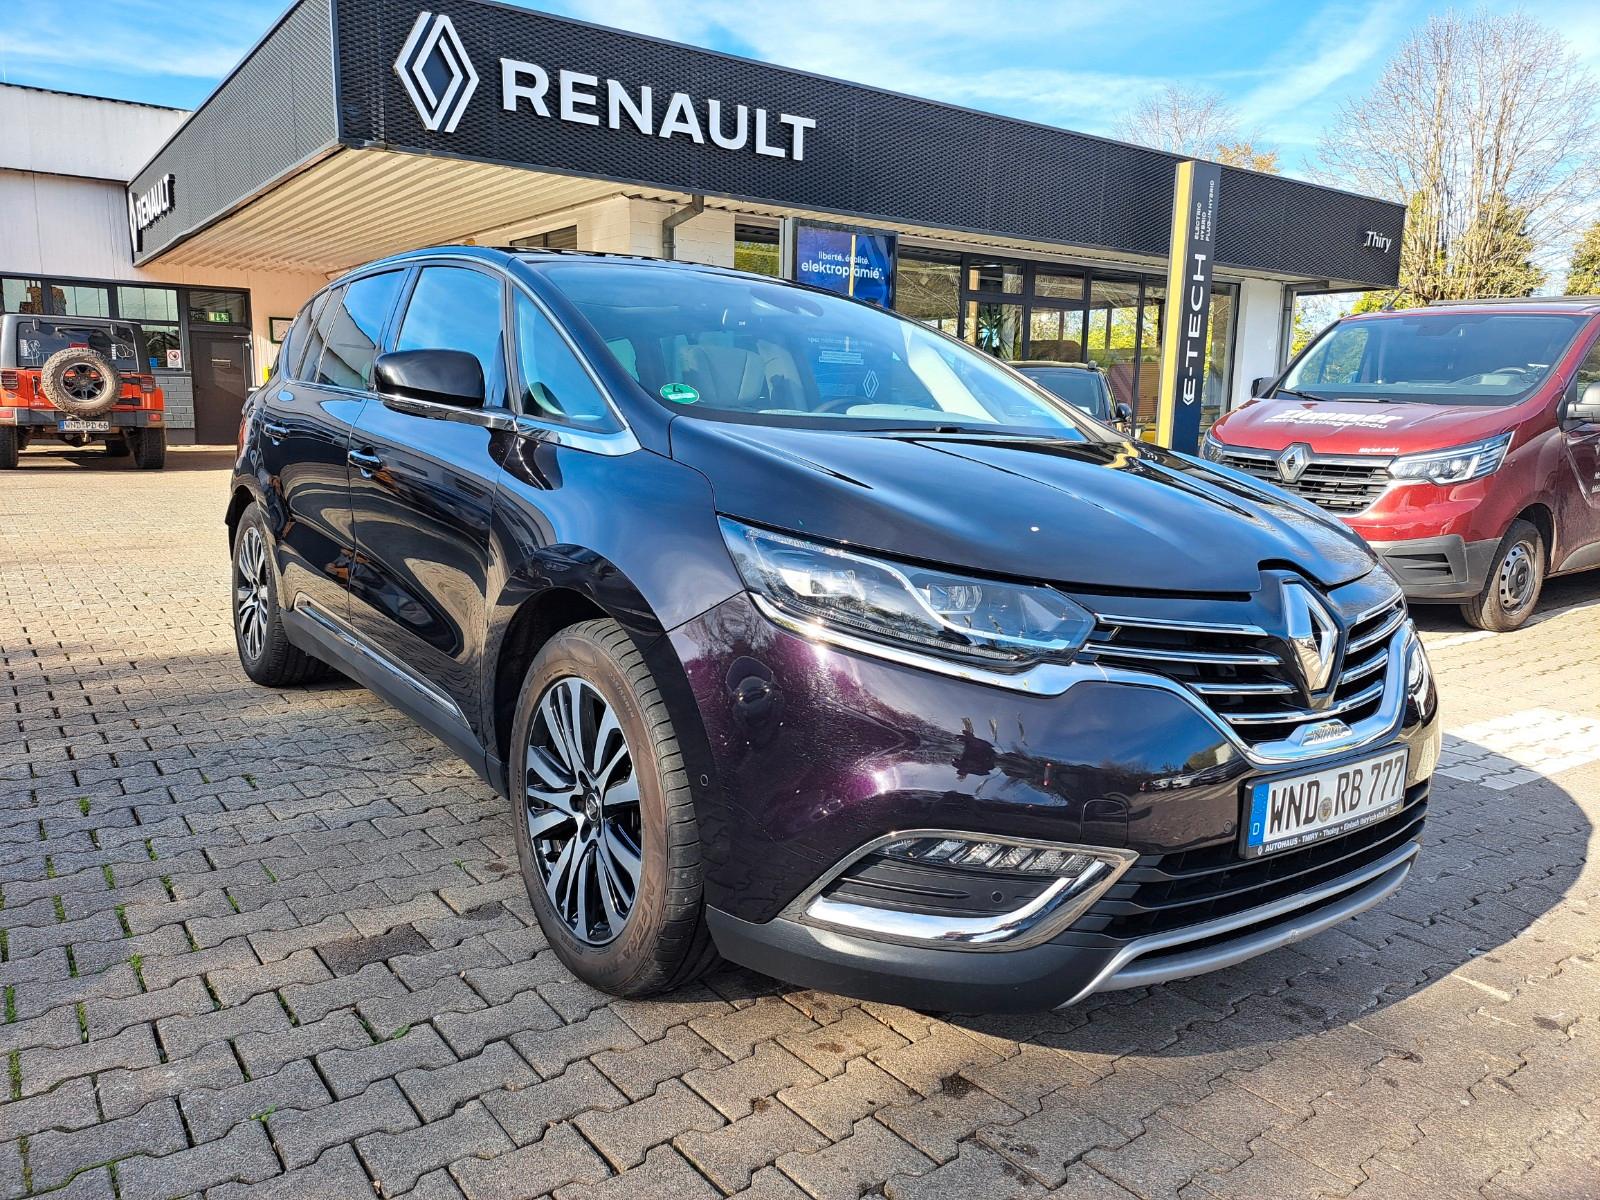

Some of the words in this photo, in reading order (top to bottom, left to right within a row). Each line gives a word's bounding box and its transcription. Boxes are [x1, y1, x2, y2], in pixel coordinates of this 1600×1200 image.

[500, 57, 817, 161] RENAULT
[136, 174, 170, 231] RENAULT
[1365, 230, 1392, 253] Thiry
[1183, 254, 1207, 405] E-TECH
[1269, 780, 1320, 834] WND
[1334, 769, 1363, 816] RB
[1368, 755, 1405, 805] 777
[1253, 823, 1260, 836] D
[1264, 837, 1298, 853] AUTOHAUS
